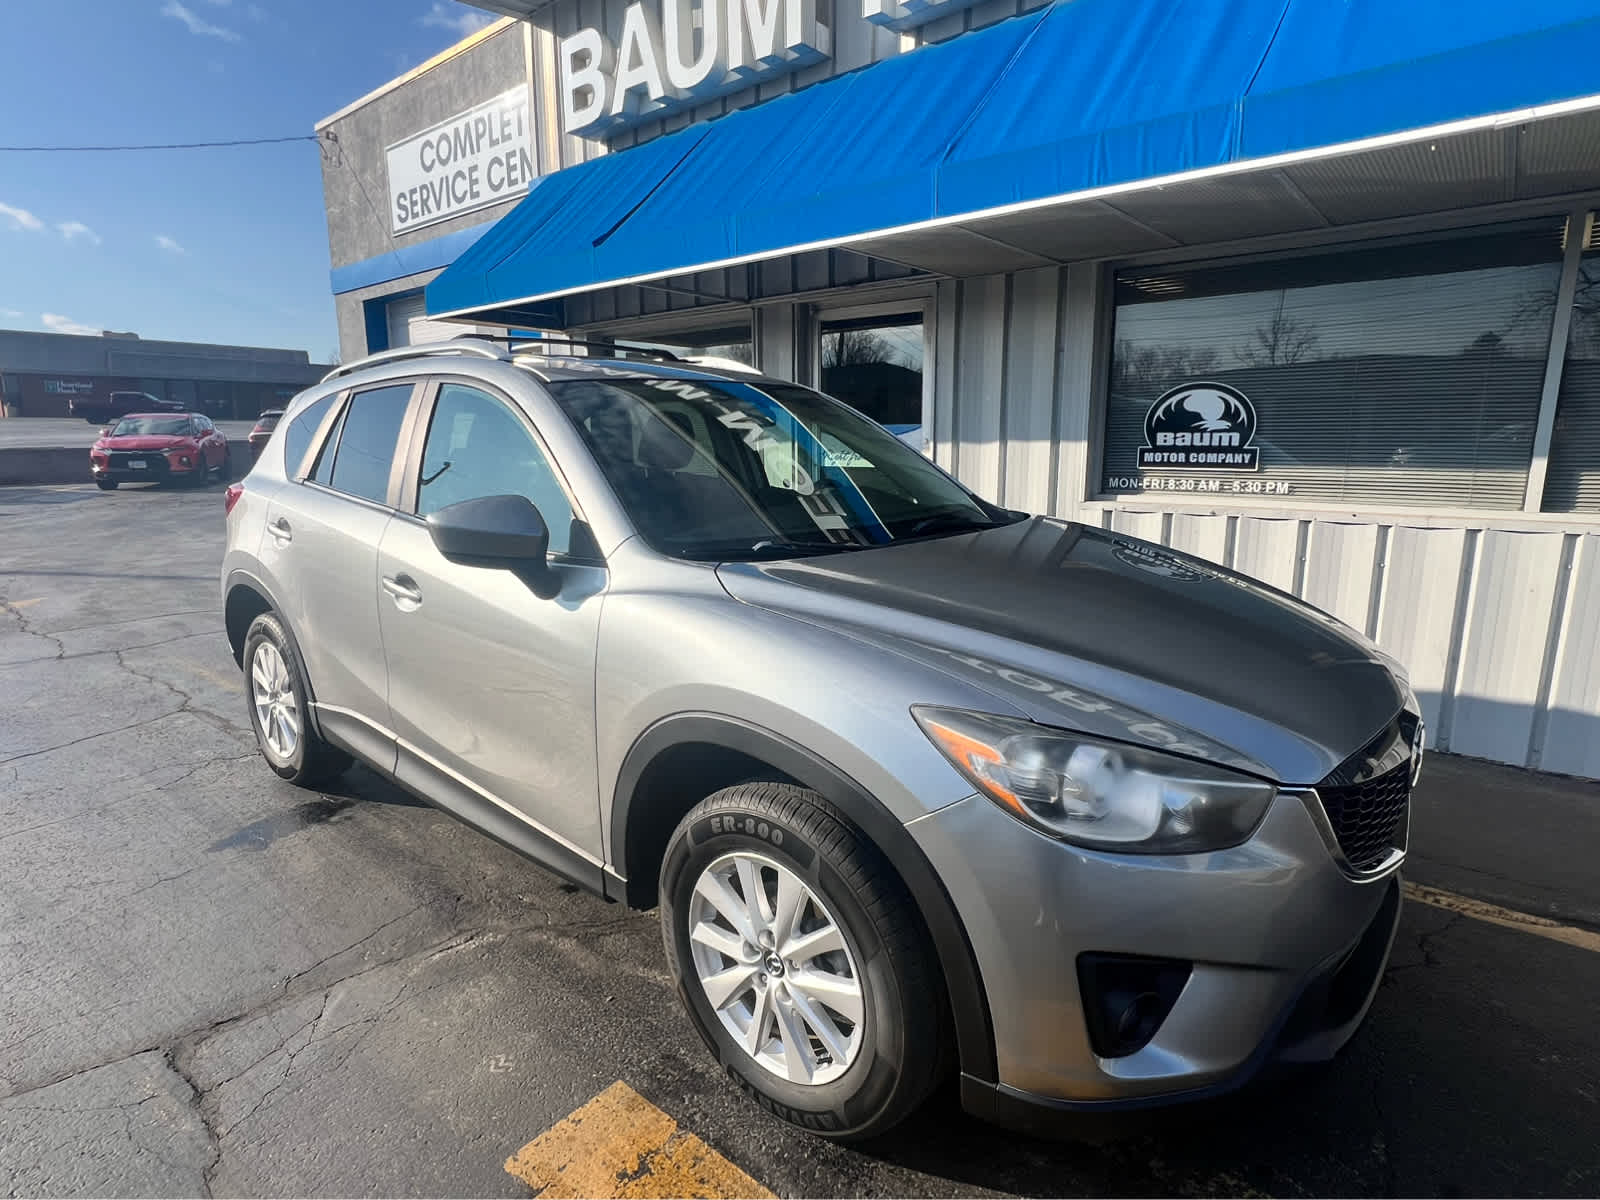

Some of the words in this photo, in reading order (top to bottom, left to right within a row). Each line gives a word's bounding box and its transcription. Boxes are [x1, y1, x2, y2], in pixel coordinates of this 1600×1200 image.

[396, 164, 481, 224] SERVICE
[1143, 452, 1186, 463] MOTOR
[1189, 452, 1252, 464] COMPANY
[1108, 477, 1165, 490] MON-FRI
[1167, 478, 1195, 491] 8:30
[1198, 479, 1221, 492] AM
[1232, 479, 1261, 493] 5:30
[1265, 481, 1289, 495] PM
[710, 815, 784, 846] ER-800
